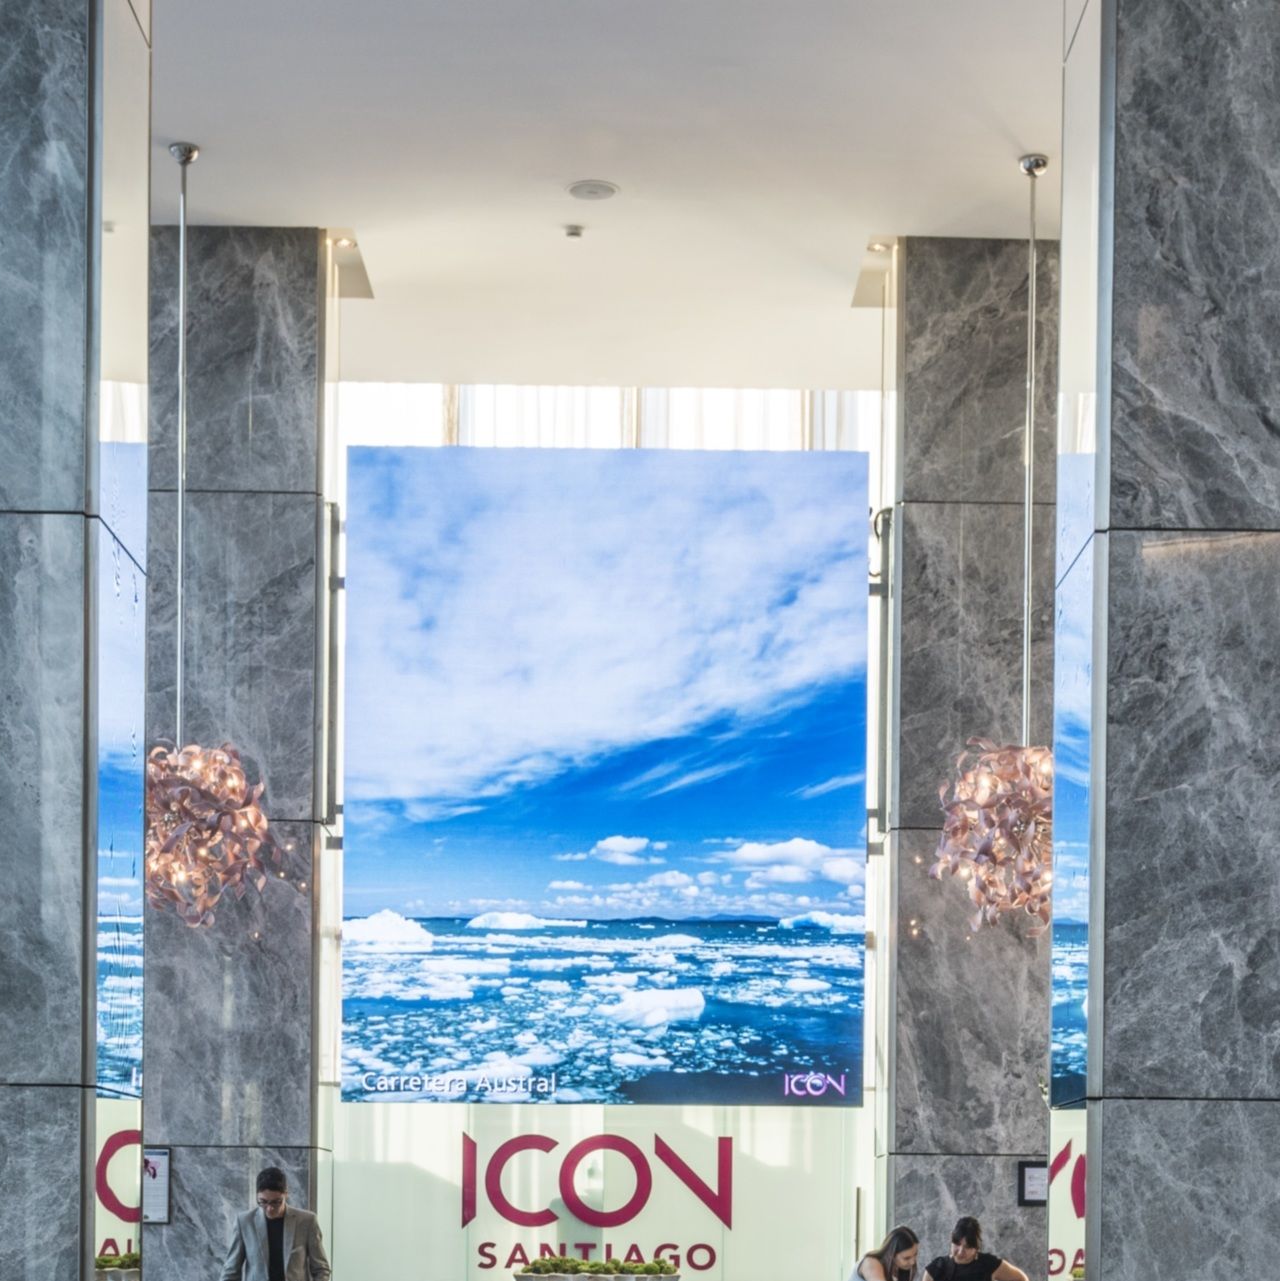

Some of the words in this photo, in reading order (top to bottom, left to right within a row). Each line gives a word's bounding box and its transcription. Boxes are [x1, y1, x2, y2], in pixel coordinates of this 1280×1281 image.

[361, 1072, 467, 1093] Carretera
[475, 1073, 557, 1093] Austral
[784, 1073, 846, 1096] ICON
[461, 1131, 733, 1231] ICON
